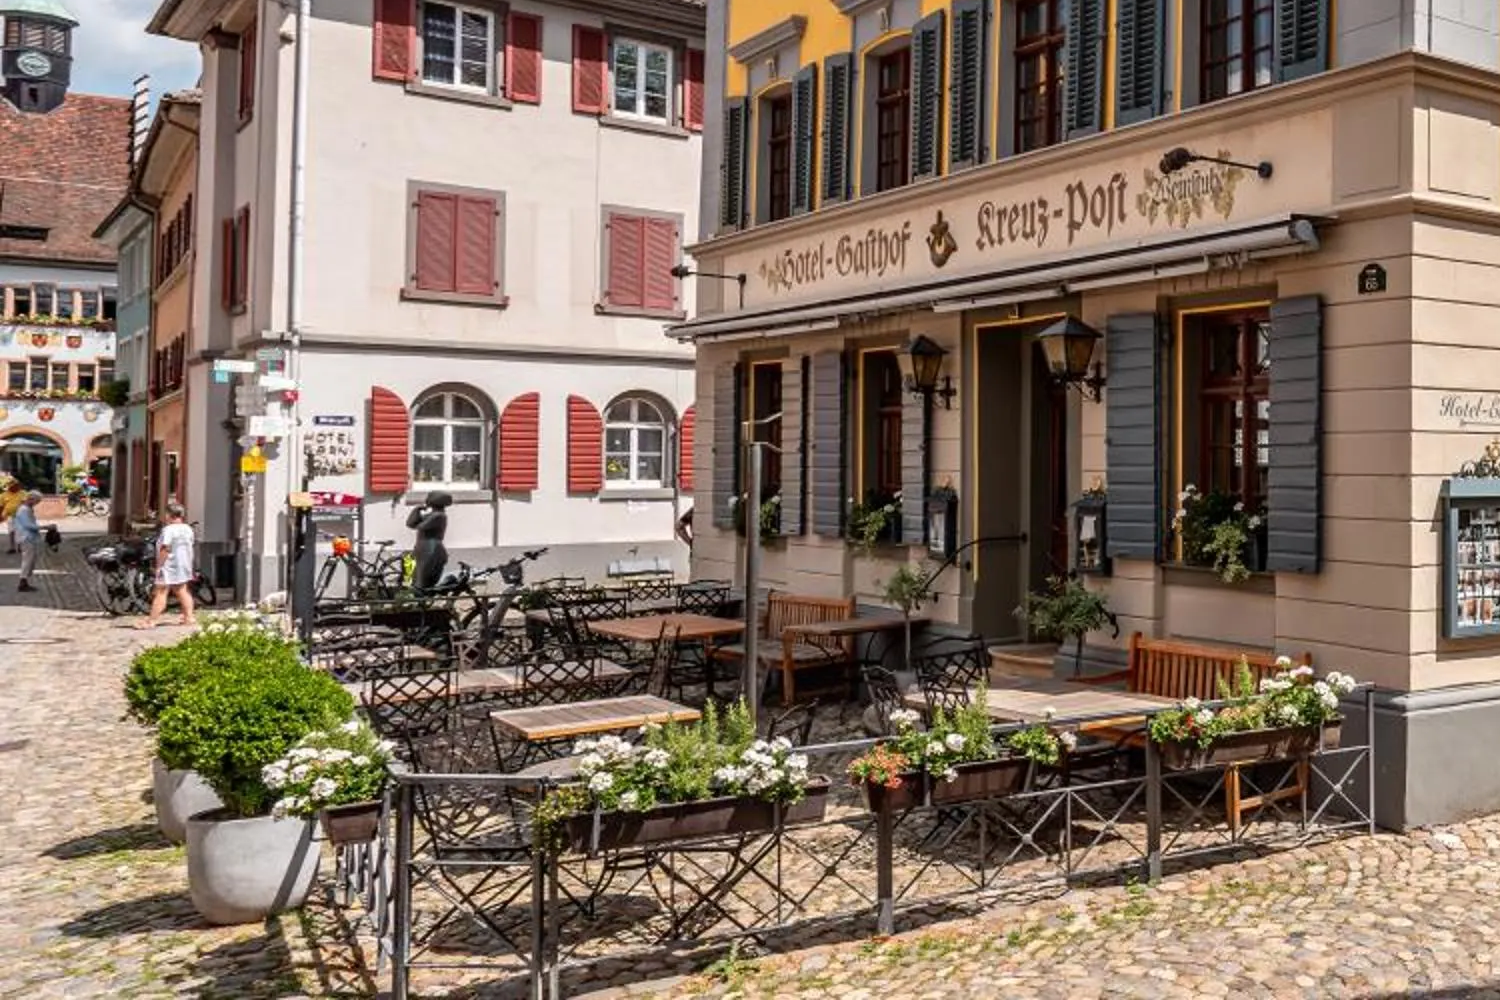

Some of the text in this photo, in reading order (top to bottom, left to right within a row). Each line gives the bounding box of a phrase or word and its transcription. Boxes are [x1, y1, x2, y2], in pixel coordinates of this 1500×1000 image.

[781, 172, 1129, 290] Hotel-Gasthof Kreuz-Post
[304, 431, 354, 446] HOTEL
